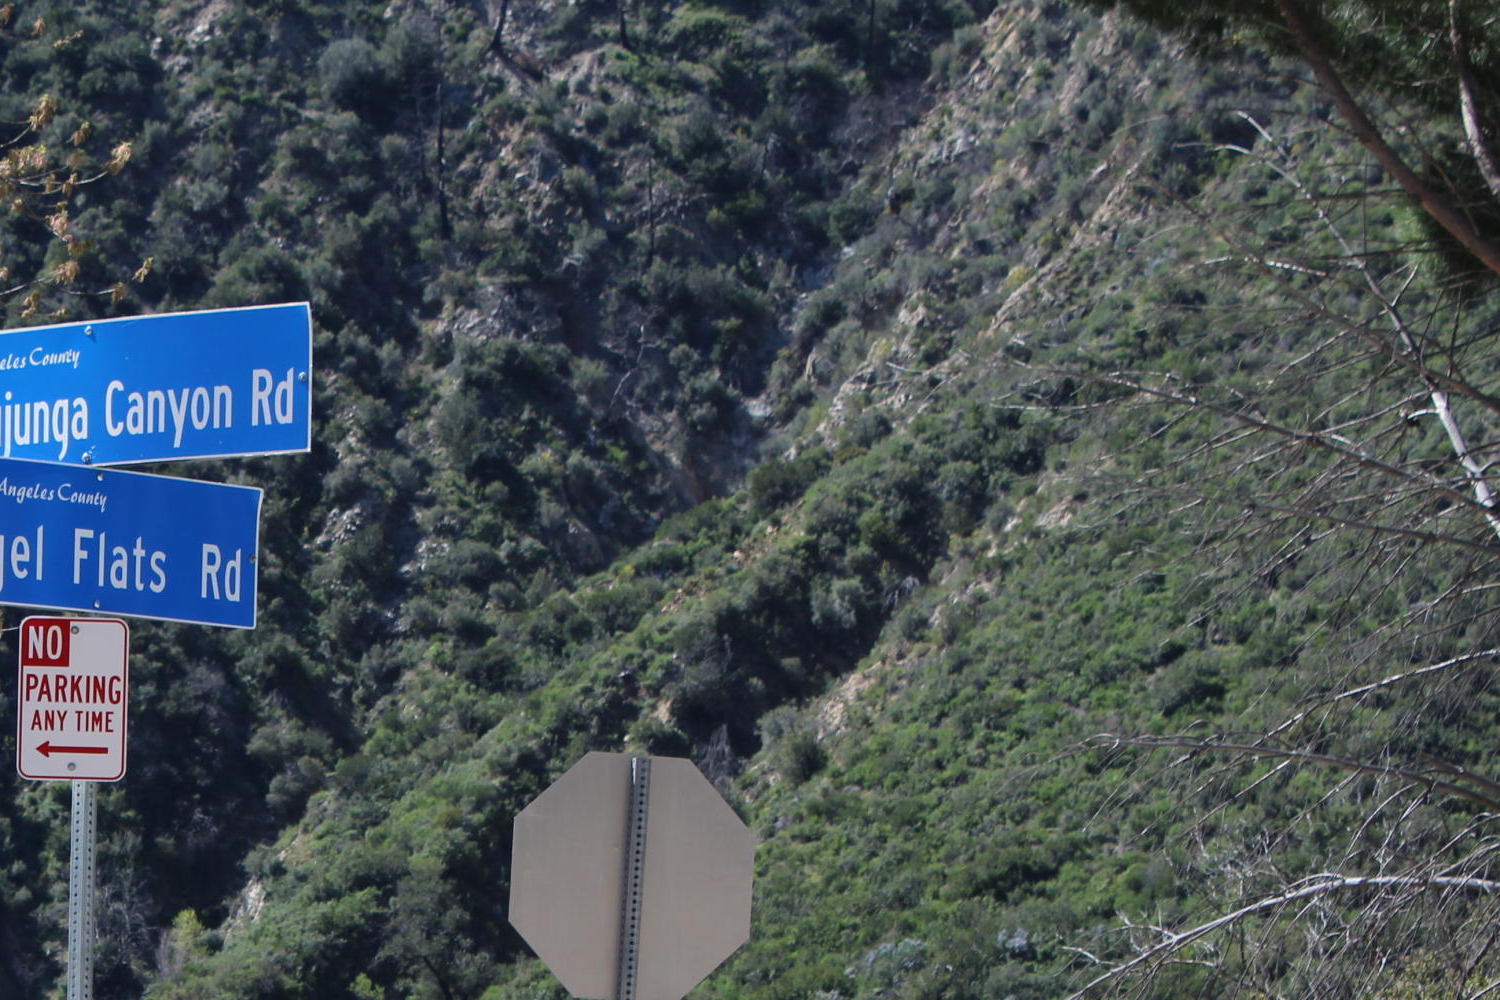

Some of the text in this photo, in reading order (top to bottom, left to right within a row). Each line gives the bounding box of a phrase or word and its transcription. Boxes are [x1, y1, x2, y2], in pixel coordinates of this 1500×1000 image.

[29, 347, 81, 369] County
[104, 379, 233, 448] Canyon
[251, 367, 295, 426] Rd
[57, 483, 108, 513] County
[73, 527, 167, 594] Flats
[200, 543, 242, 602] Rd
[28, 625, 63, 660] NO
[25, 673, 122, 705] PARKING
[31, 709, 115, 733] ANY TIME
